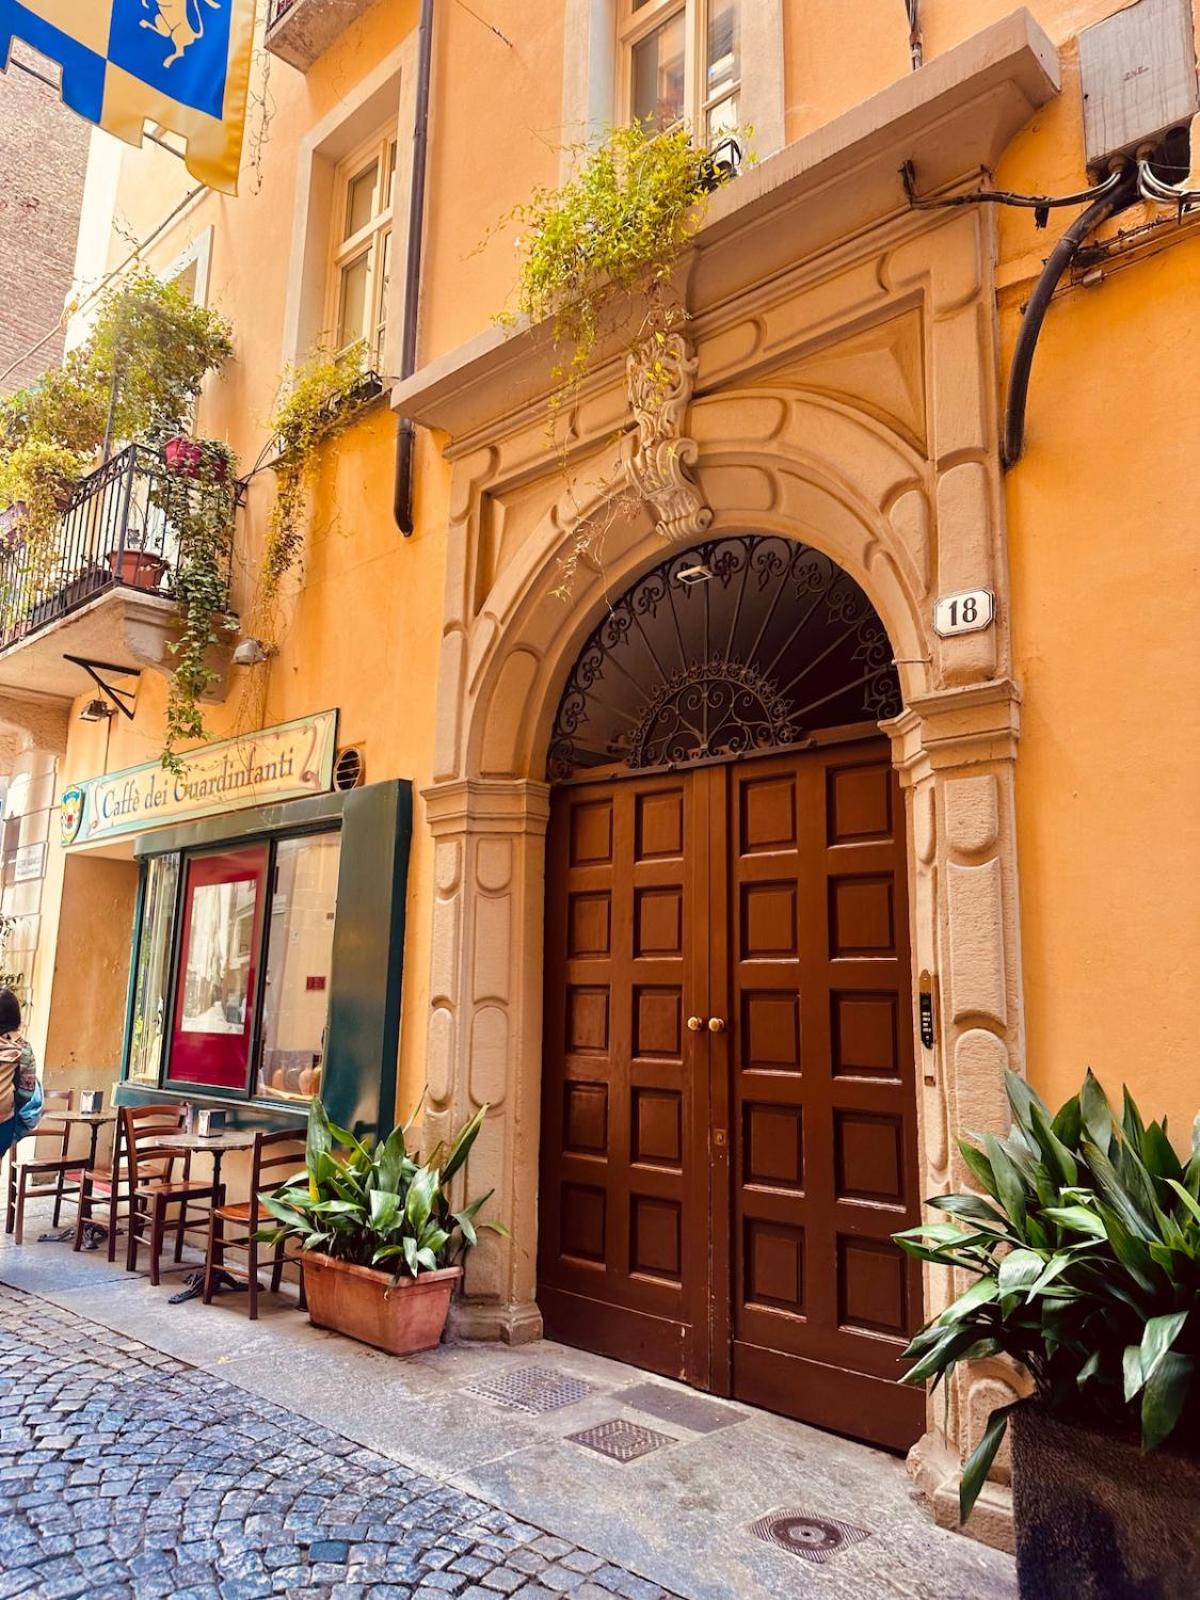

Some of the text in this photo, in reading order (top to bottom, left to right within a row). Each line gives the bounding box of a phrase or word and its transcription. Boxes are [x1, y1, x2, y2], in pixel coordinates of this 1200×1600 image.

[948, 597, 977, 626] 18
[103, 746, 294, 818] Caffè dei Guardinfanti
